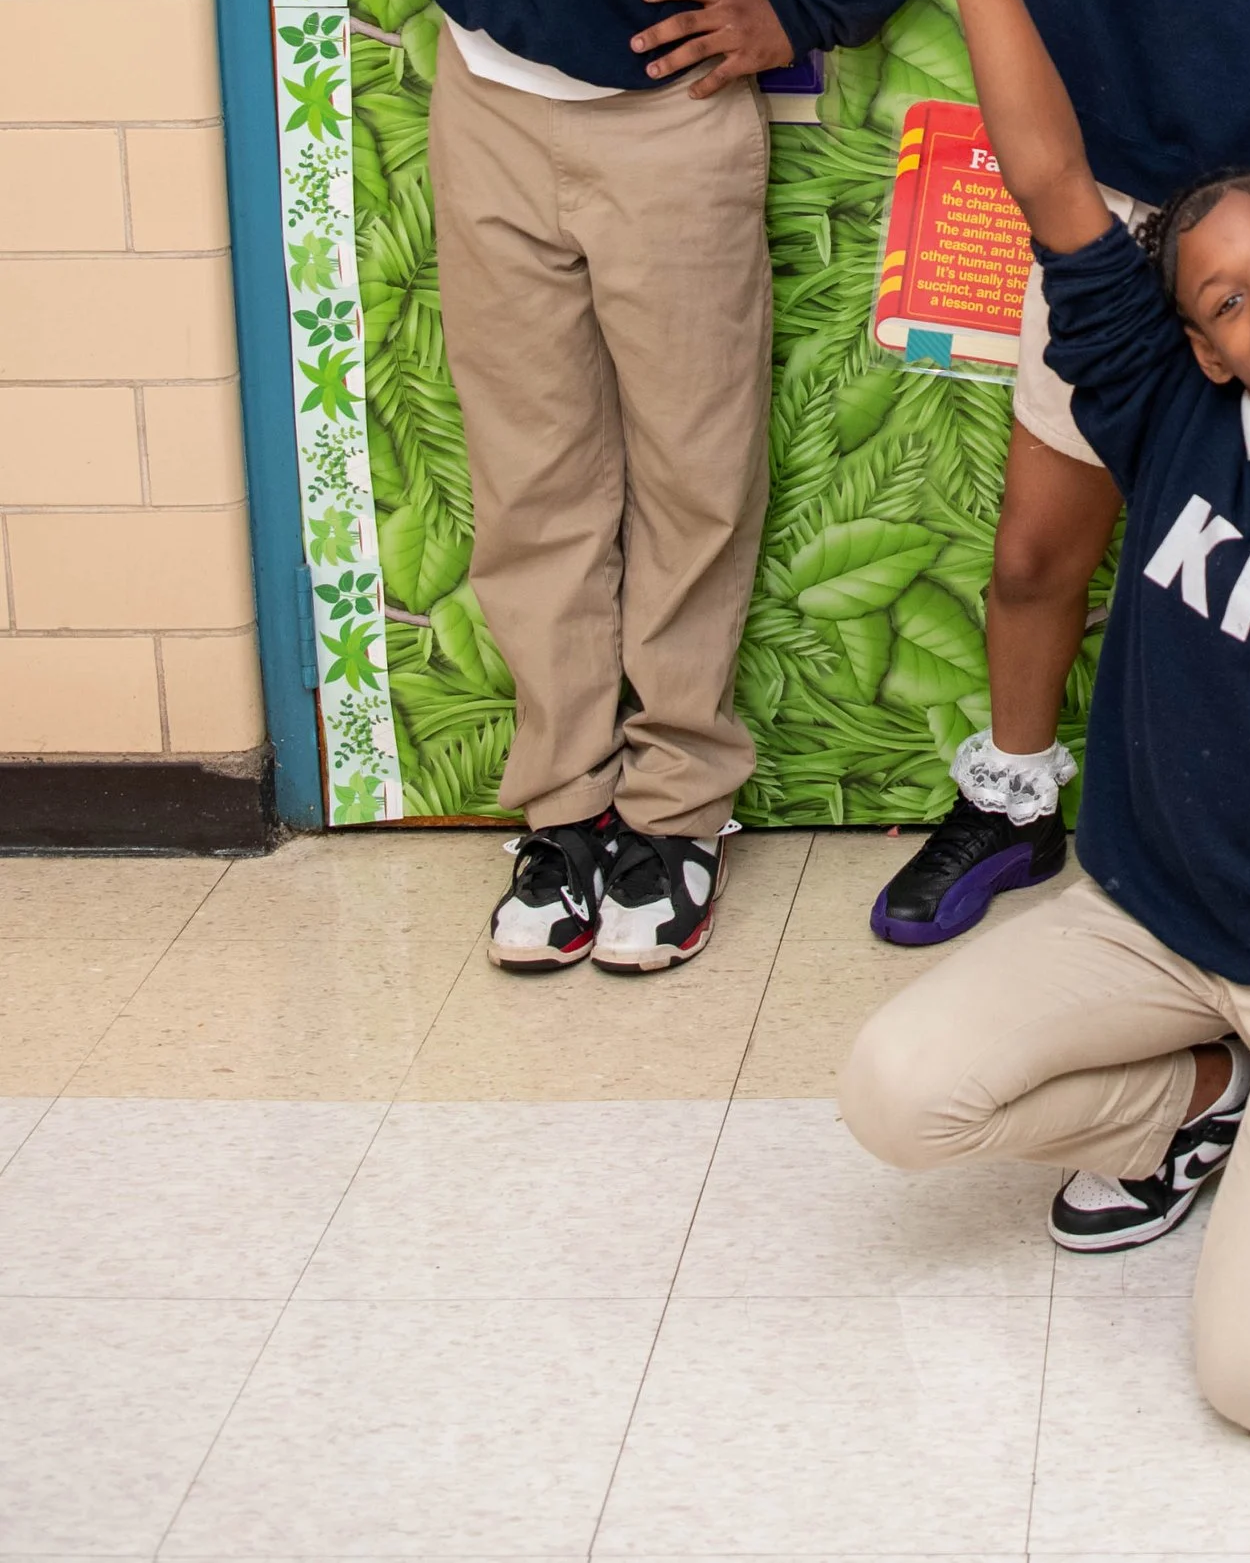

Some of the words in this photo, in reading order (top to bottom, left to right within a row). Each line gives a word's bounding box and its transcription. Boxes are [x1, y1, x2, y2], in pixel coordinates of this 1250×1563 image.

[952, 179, 962, 192] A
[965, 183, 998, 200] story
[942, 193, 963, 207] the
[966, 197, 1022, 215] characte
[935, 221, 960, 235] The
[962, 227, 1013, 244] animals
[947, 211, 992, 229] usually
[995, 218, 1032, 232] anim
[920, 250, 955, 264] other
[957, 254, 1002, 272] human
[939, 239, 987, 256] reason,
[990, 246, 1015, 258] and
[1018, 248, 1034, 261] ha
[917, 279, 972, 298] succinct,
[976, 288, 1001, 301] and
[958, 272, 1003, 288] usually
[930, 296, 939, 306] a
[942, 295, 984, 312] lesson
[986, 305, 1001, 315] or
